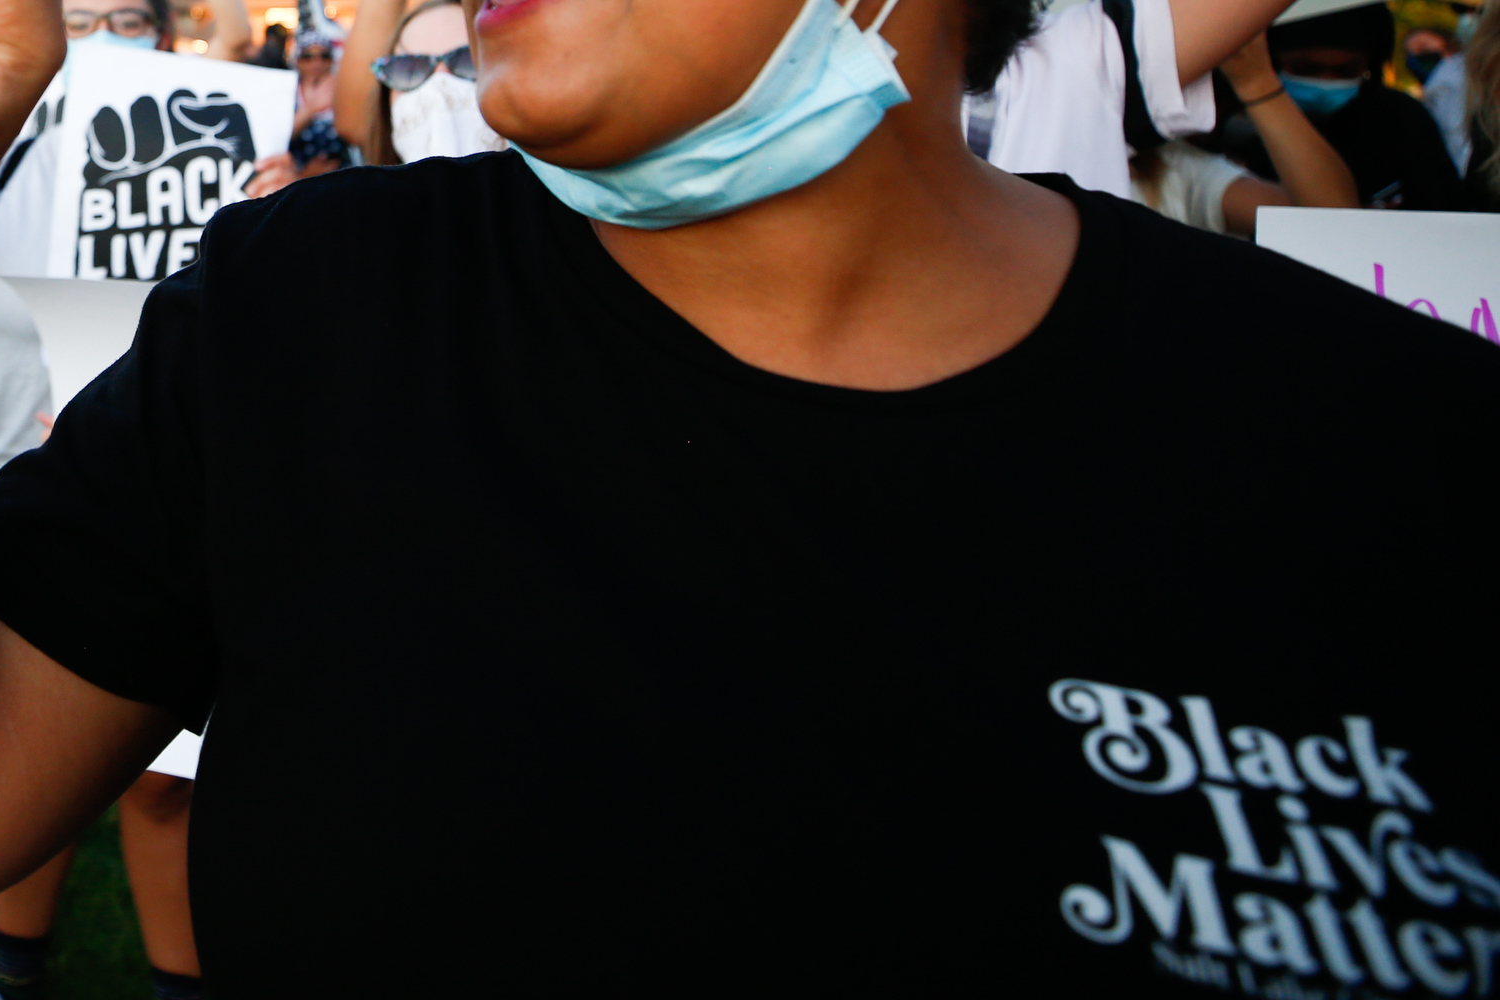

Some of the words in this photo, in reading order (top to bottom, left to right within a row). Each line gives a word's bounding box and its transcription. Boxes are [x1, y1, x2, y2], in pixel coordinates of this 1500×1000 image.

[77, 227, 207, 281] LIVE
[81, 156, 255, 232] BLACK
[1047, 677, 1434, 813] Black
[1200, 782, 1500, 908] Lives
[1059, 834, 1500, 997] Matter
